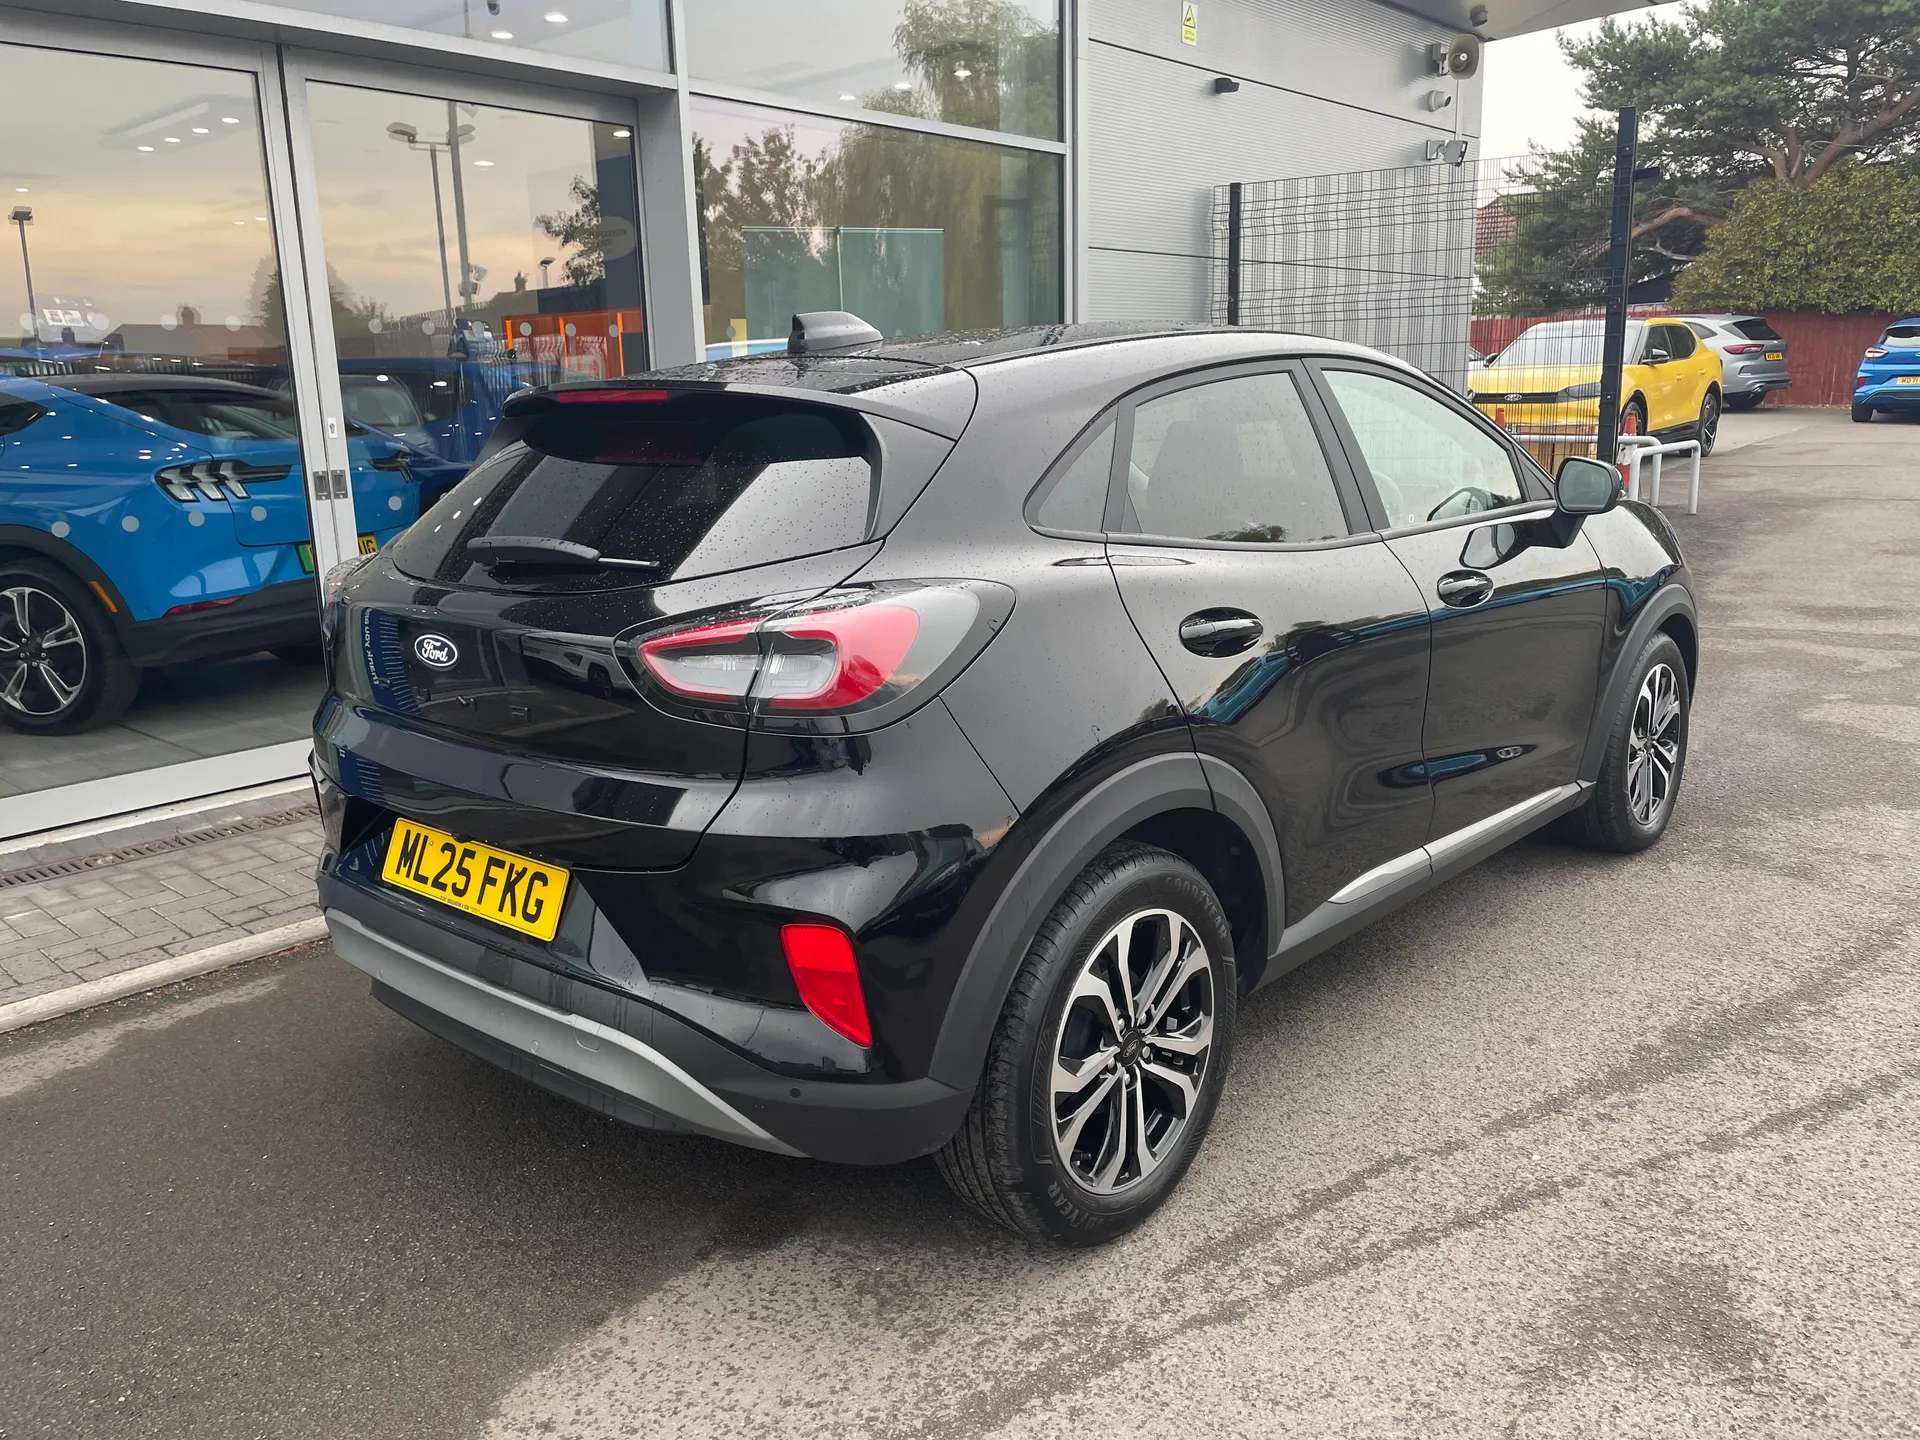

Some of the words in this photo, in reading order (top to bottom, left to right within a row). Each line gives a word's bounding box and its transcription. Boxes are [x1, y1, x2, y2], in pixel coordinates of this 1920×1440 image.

[421, 638, 449, 662] Ford
[395, 829, 477, 898] ML25
[476, 855, 549, 925] FKG
